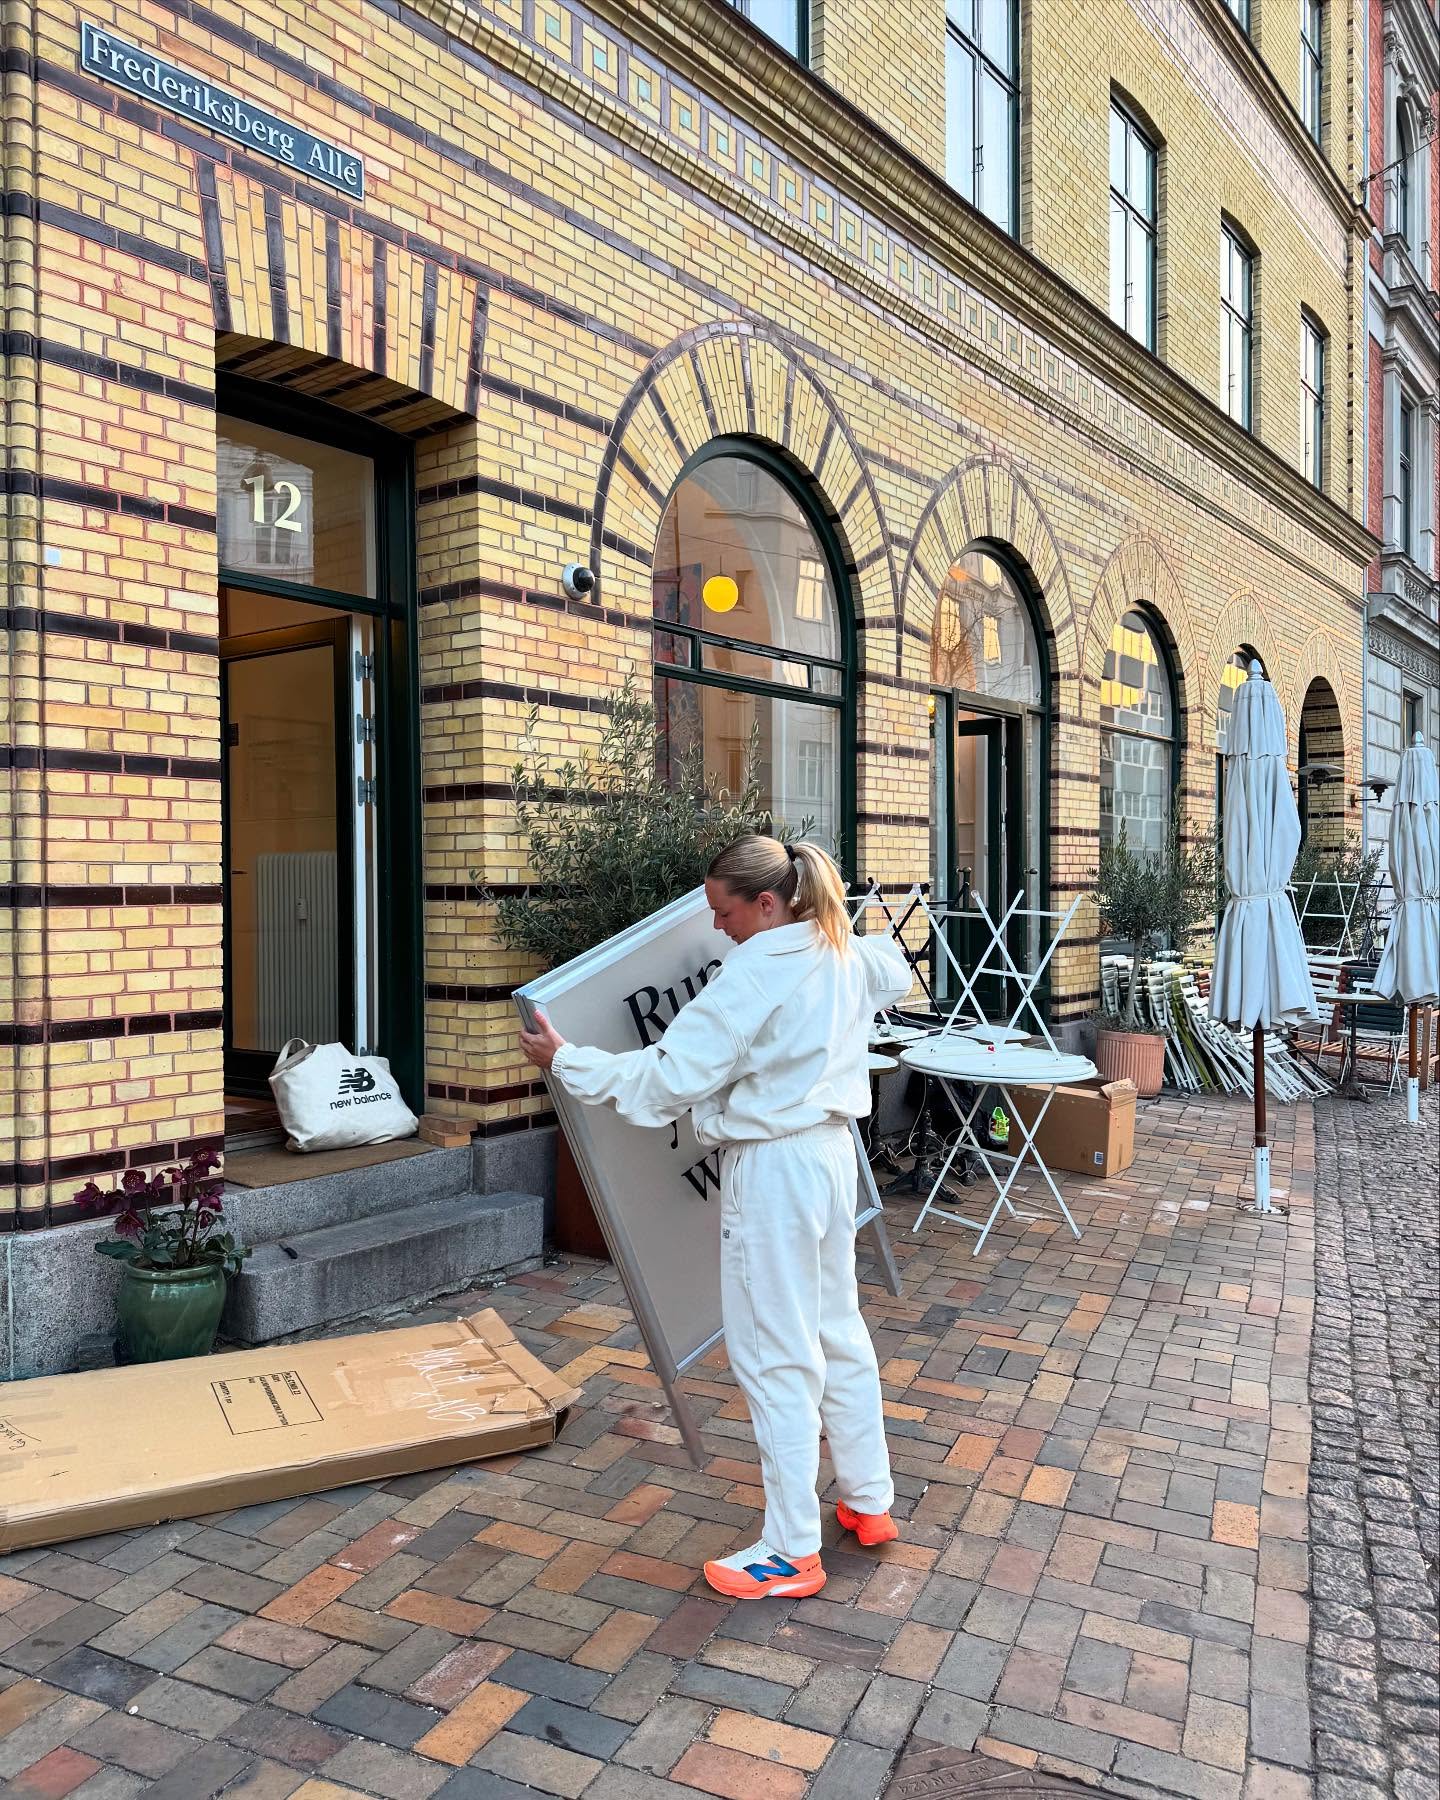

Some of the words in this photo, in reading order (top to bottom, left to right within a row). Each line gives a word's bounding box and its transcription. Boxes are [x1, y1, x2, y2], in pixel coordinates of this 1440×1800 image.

[89, 31, 295, 162] Frederiksberg
[307, 142, 357, 186] Allé
[244, 474, 302, 533] 12
[330, 1098, 352, 1110] new
[353, 1092, 392, 1105] balance
[743, 1554, 801, 1583] N
